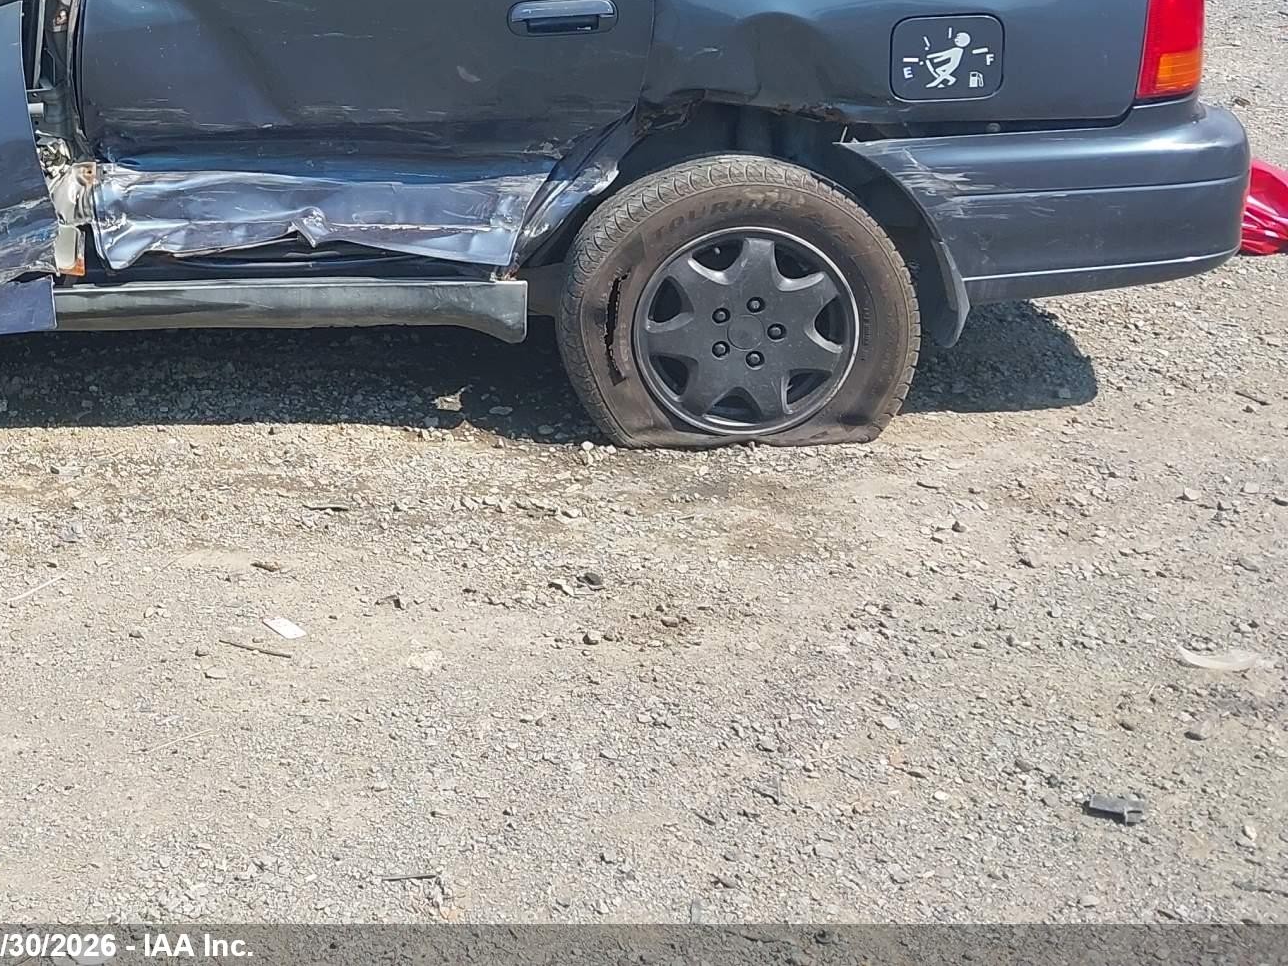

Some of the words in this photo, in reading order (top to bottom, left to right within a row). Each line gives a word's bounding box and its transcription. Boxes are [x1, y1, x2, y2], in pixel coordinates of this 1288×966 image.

[985, 53, 995, 66] F
[902, 66, 914, 80] E
[655, 200, 793, 240] TOURING
